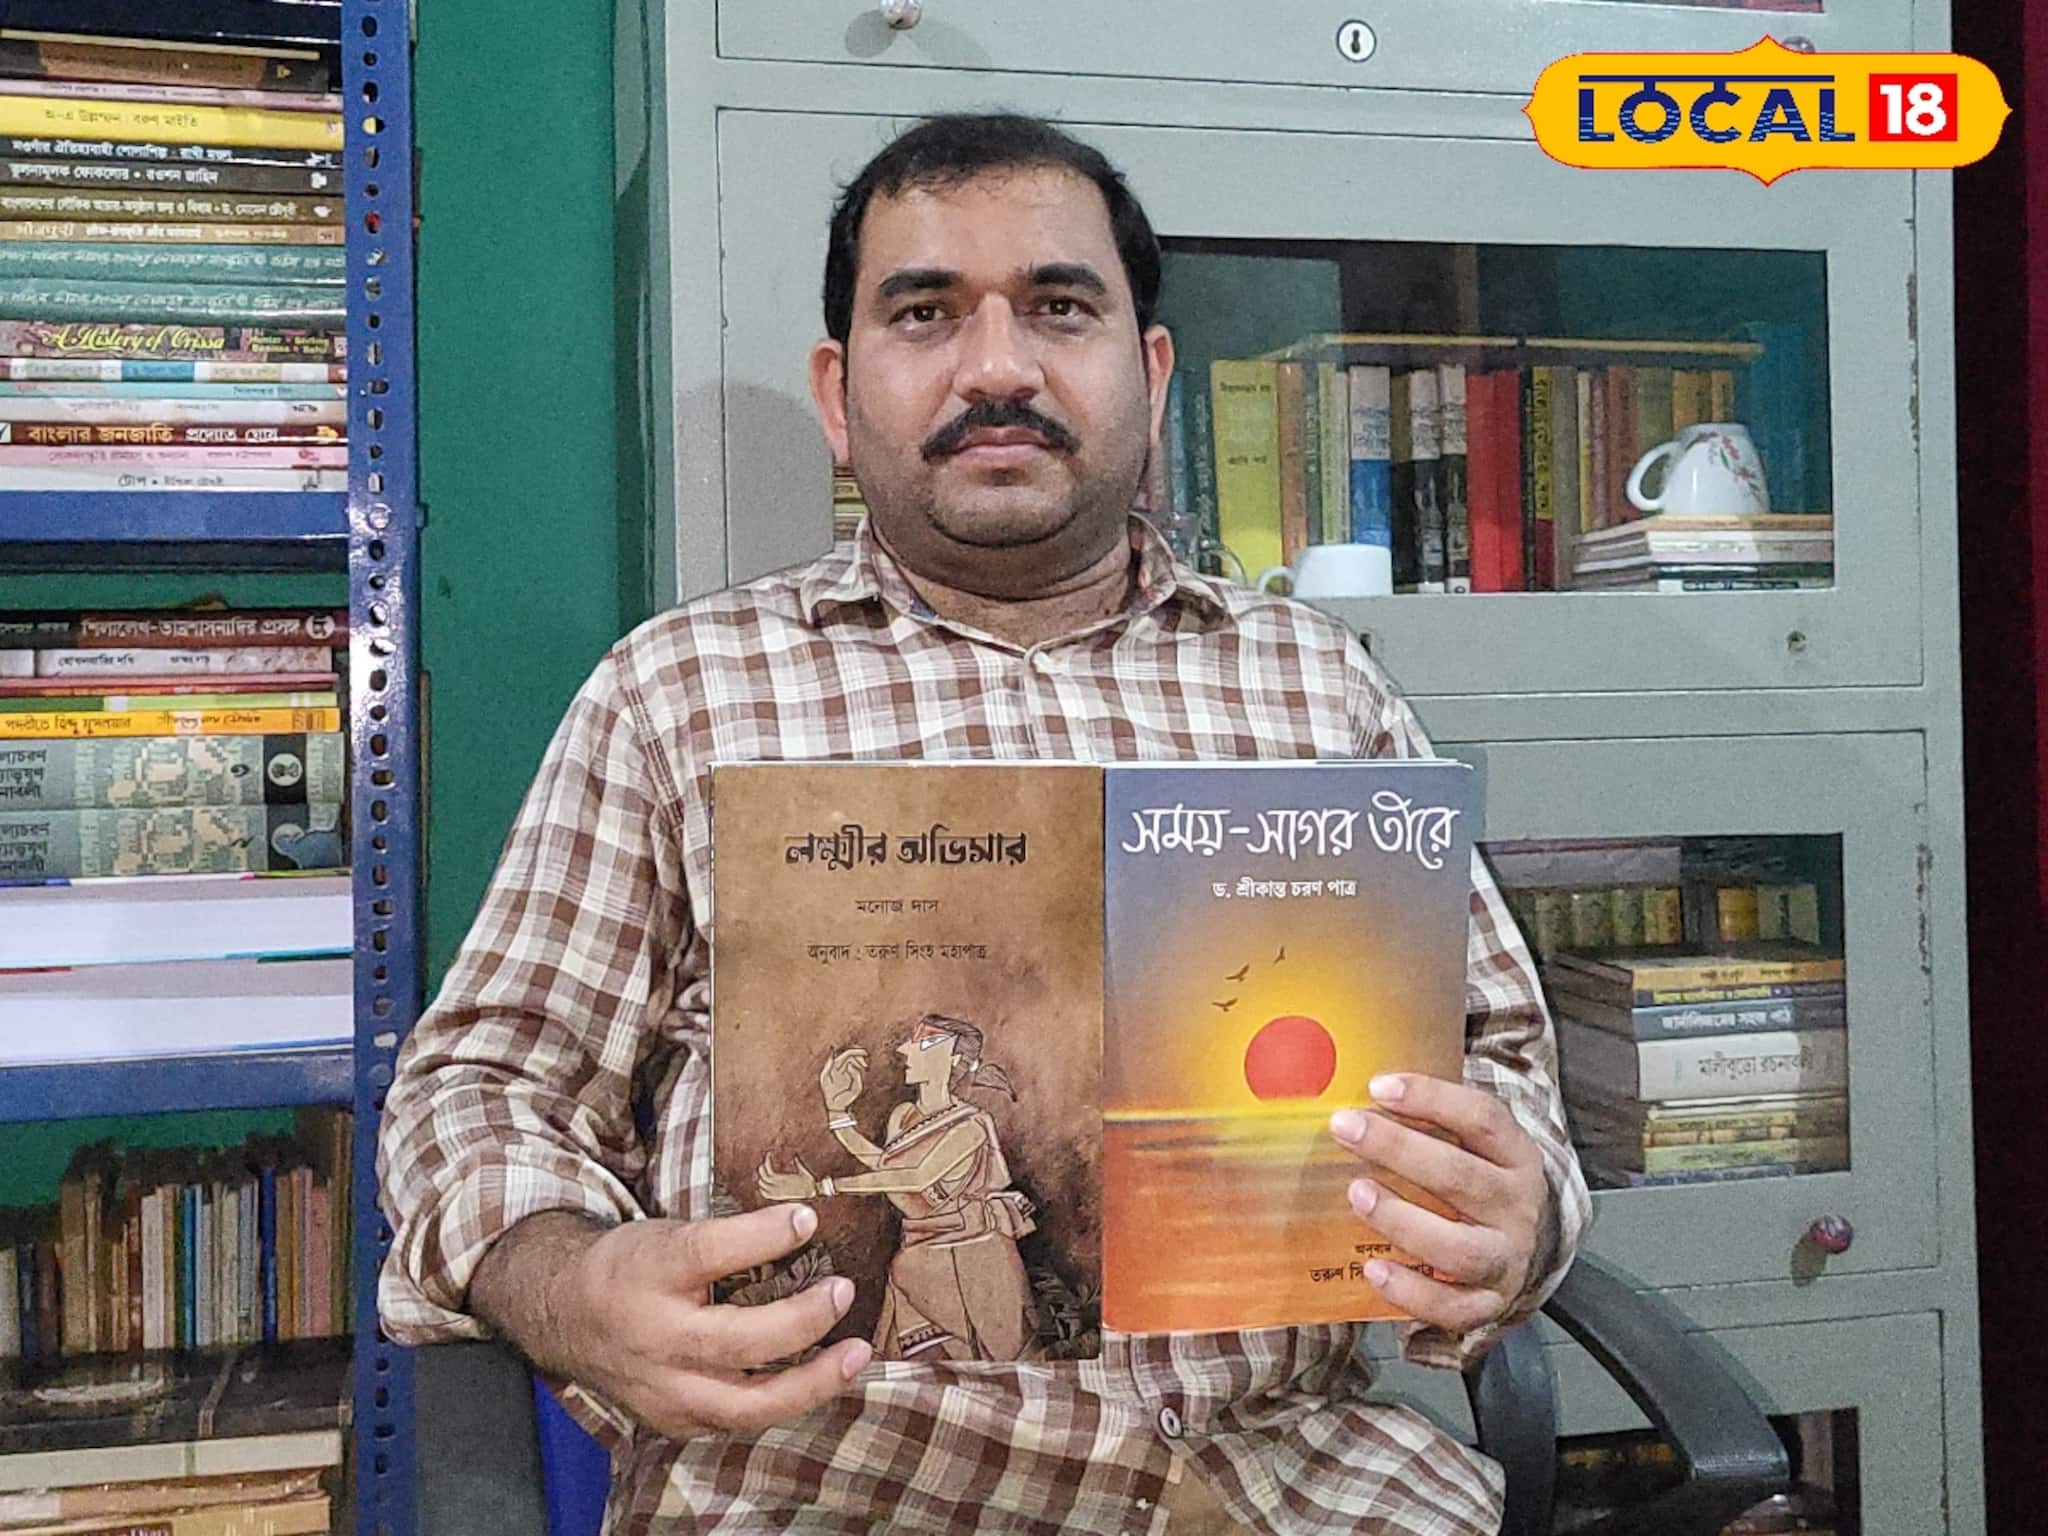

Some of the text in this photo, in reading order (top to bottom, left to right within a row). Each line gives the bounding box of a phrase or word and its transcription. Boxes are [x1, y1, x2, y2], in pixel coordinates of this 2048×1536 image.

[78, 326, 144, 353] History
[145, 326, 168, 353] of
[171, 327, 225, 351] Orissa
[28, 425, 91, 443] বাংলার
[97, 422, 175, 443] জনজাতি
[260, 618, 300, 636] প্রসঙ্গ
[1122, 790, 1462, 870] সময়-সাগর তীরে
[784, 823, 1028, 871] লক্ষ্মীর অভিসার
[1213, 876, 1357, 898] ড. শ্রীকান্ত চরণ পাত্র
[855, 899, 940, 914] মনোজ দাস
[807, 943, 851, 965] অনুবাদ
[866, 945, 900, 960] তরুণ
[905, 940, 934, 960] সিংহ
[940, 944, 987, 961] মহাপাত্র
[1309, 1266, 1344, 1283] তরুণ
